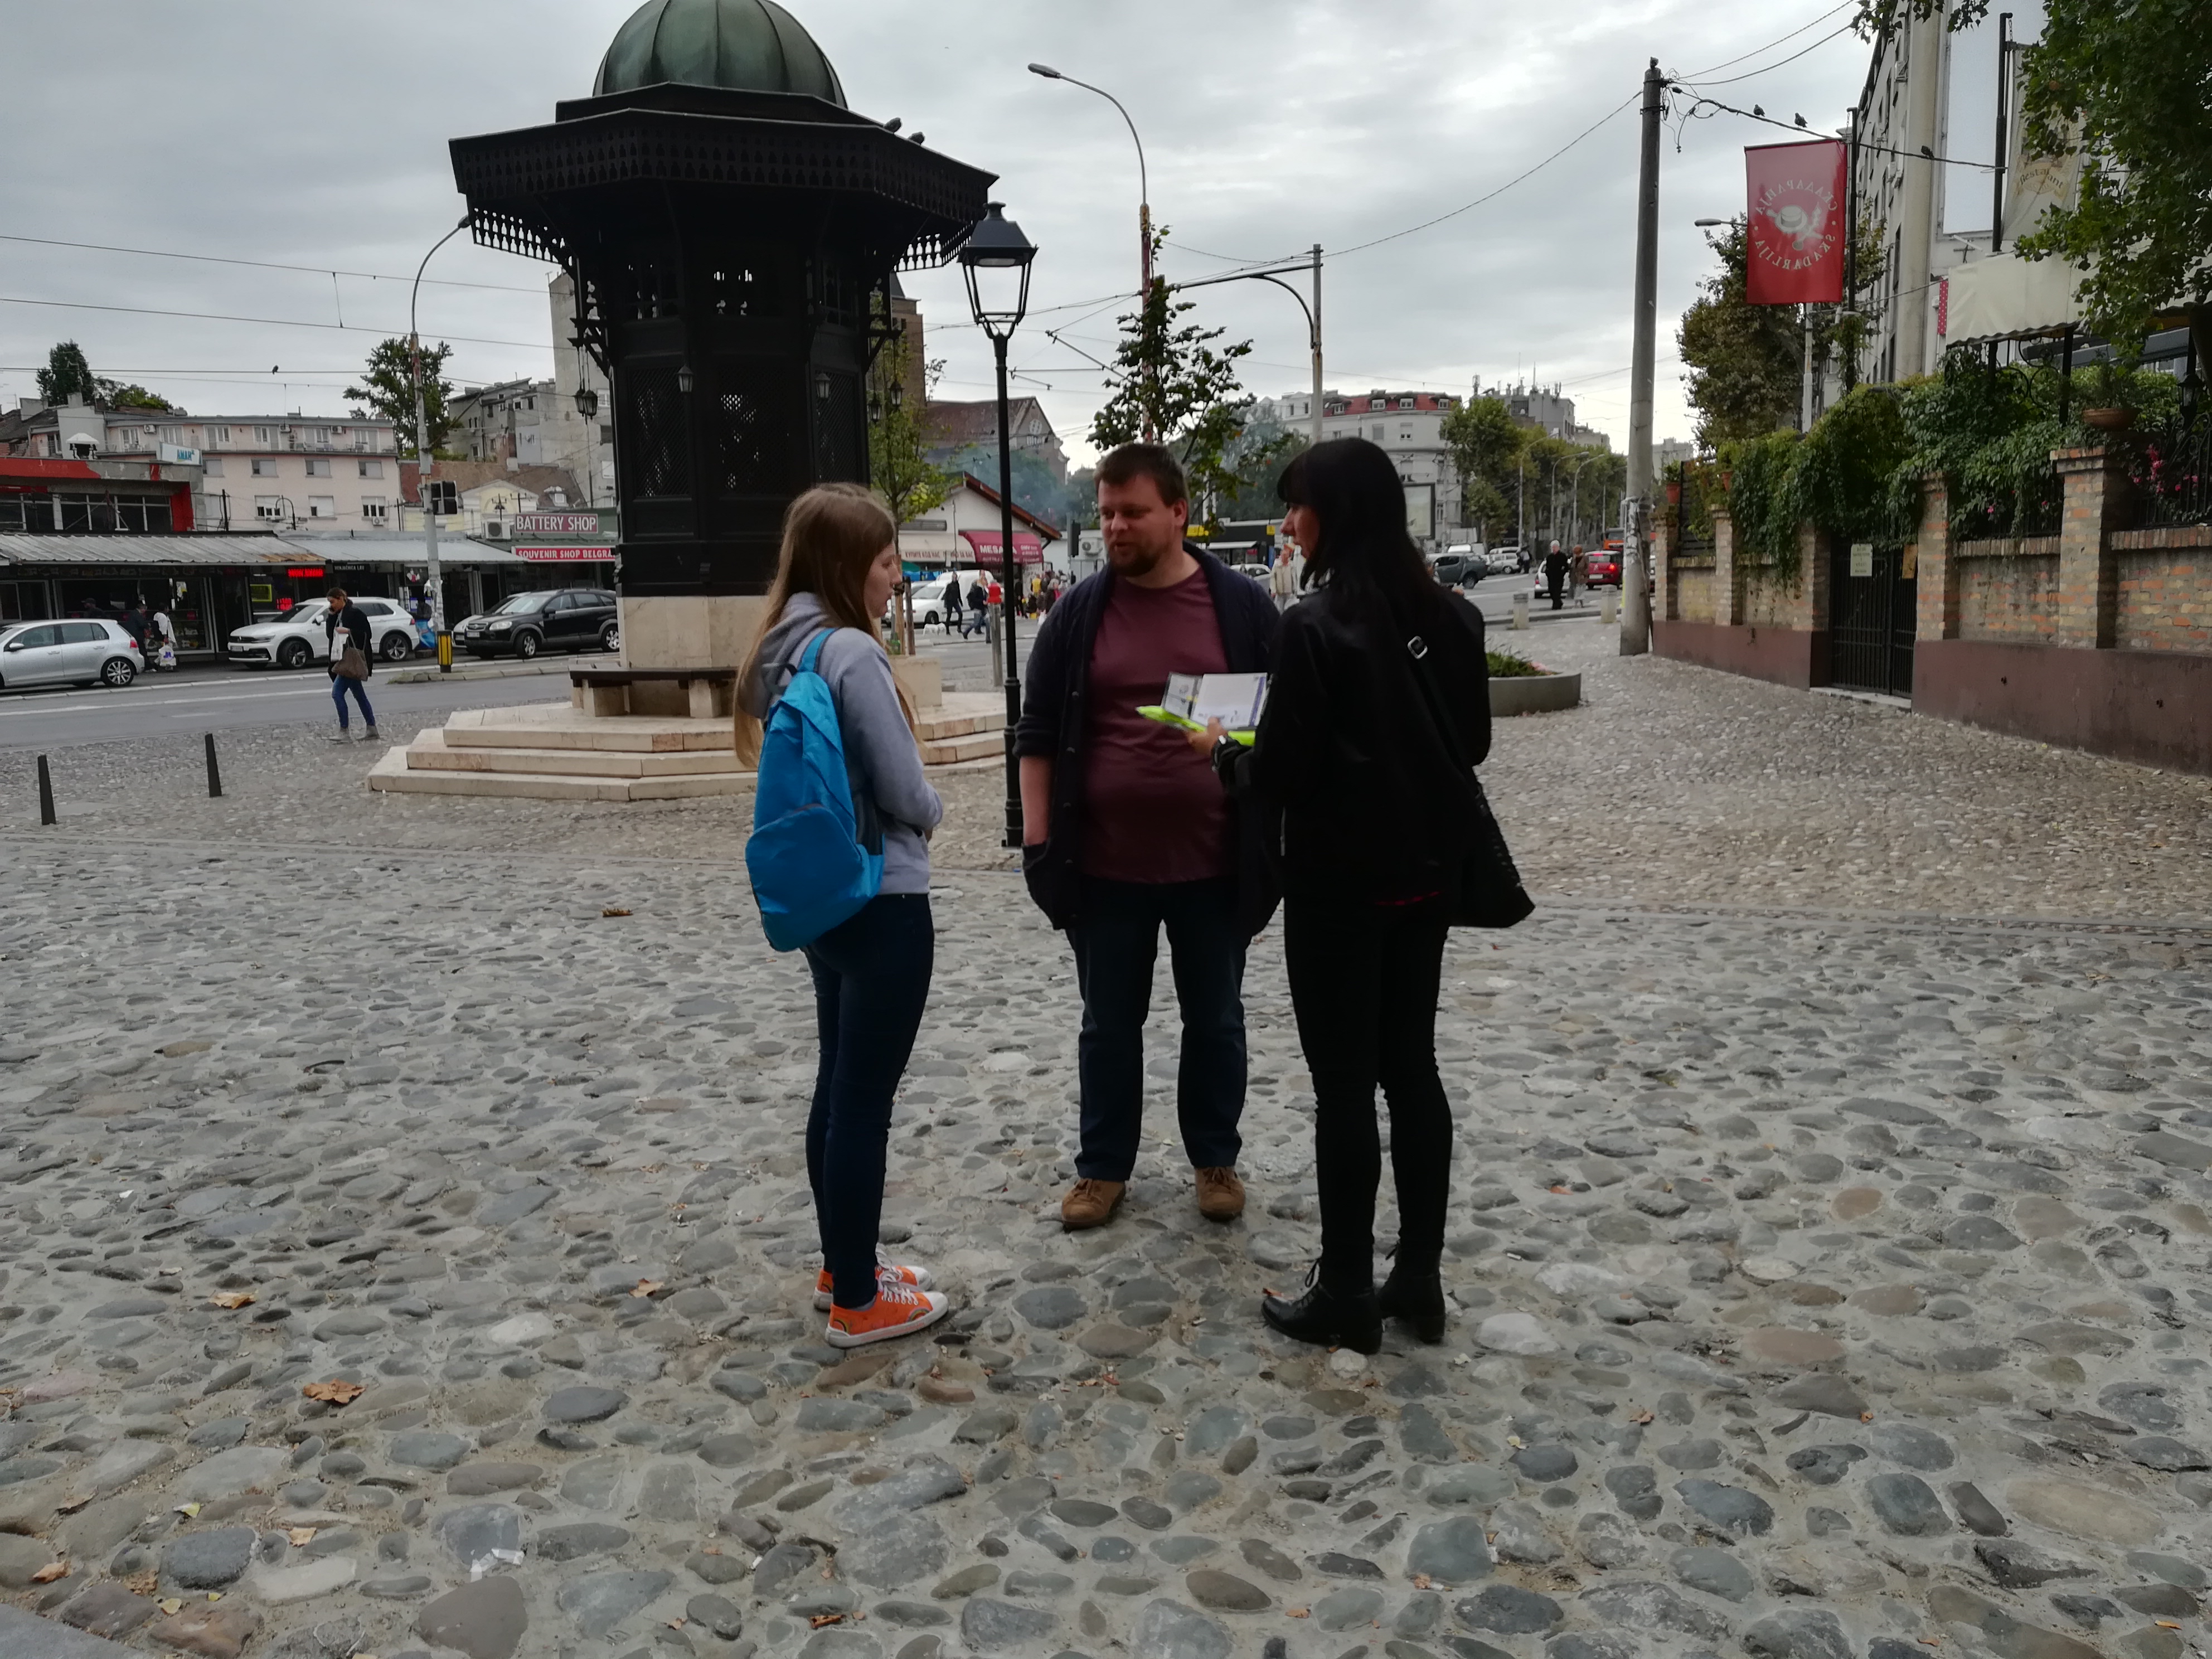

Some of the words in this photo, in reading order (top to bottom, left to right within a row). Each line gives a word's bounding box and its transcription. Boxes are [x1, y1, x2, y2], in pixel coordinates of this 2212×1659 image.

[516, 516, 564, 530] BATTERY
[567, 516, 596, 531] SHOP
[518, 550, 557, 558] SOUVENIR
[560, 550, 580, 558] SHOP
[583, 549, 615, 558] BELGRA
